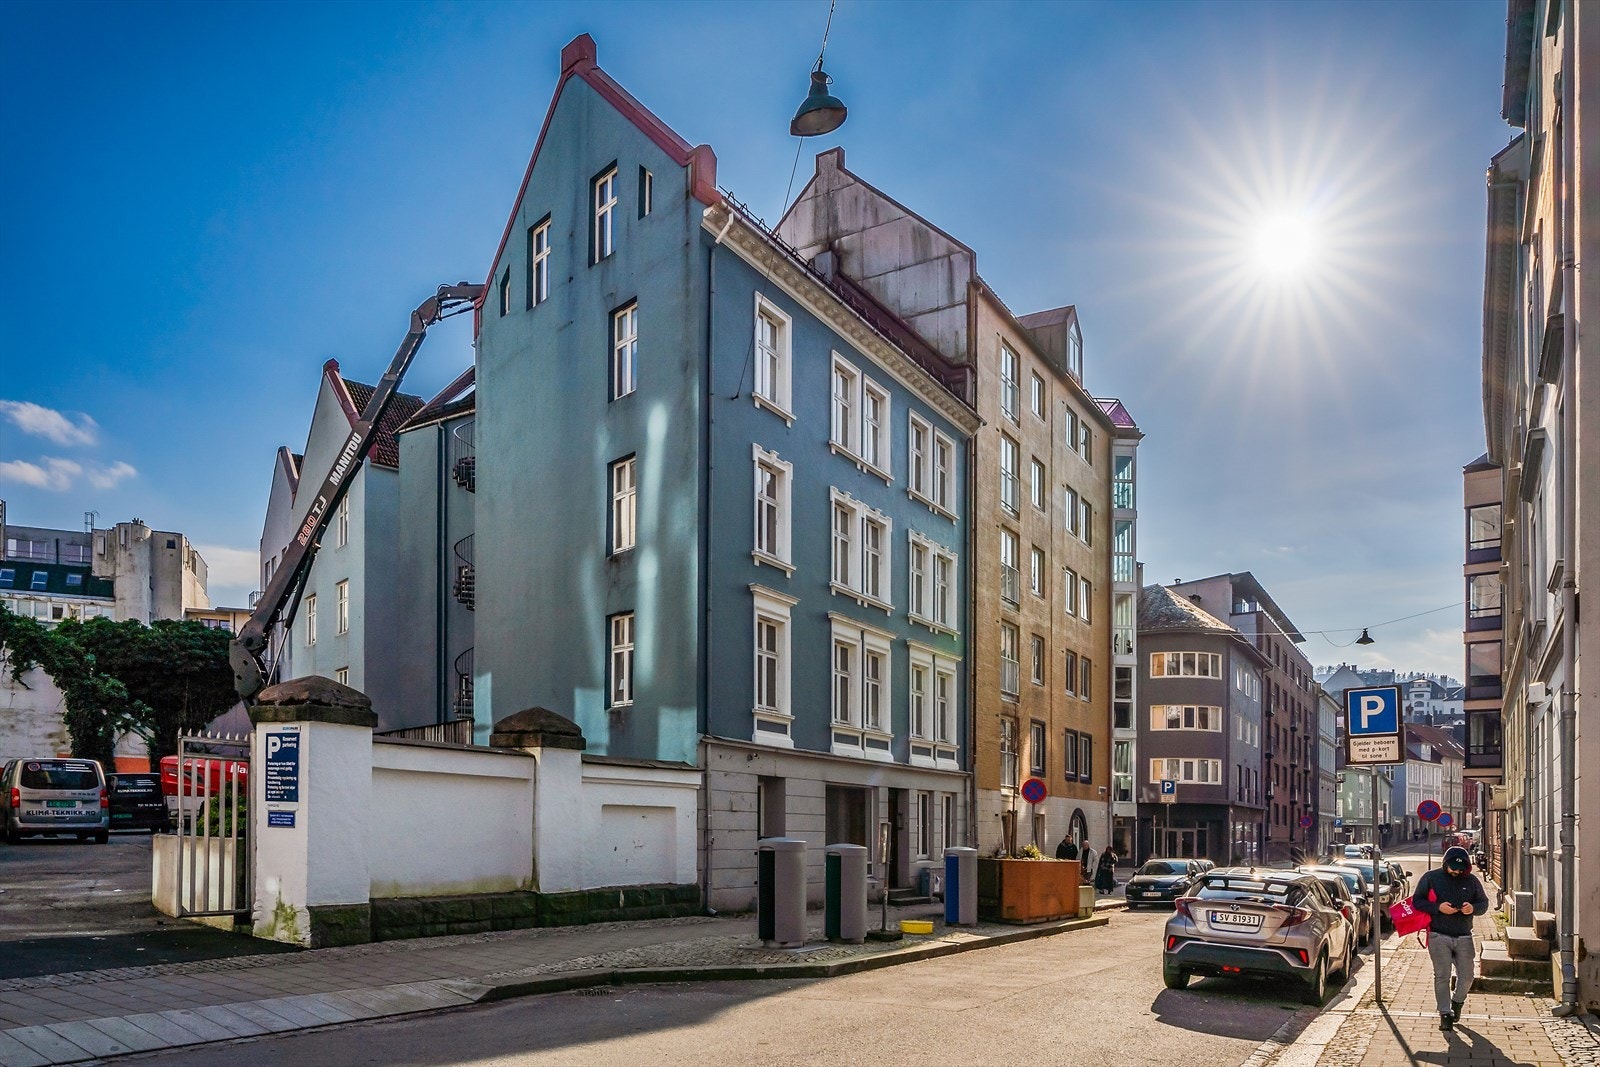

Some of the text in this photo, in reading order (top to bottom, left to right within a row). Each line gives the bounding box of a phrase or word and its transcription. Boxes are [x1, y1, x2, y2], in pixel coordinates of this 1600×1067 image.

[329, 432, 362, 486] MANITOU
[298, 495, 327, 546] 280 TJ
[1360, 695, 1385, 729] P
[267, 736, 281, 759] P
[1164, 781, 1172, 793] P
[1219, 913, 1256, 924] SV 81931
